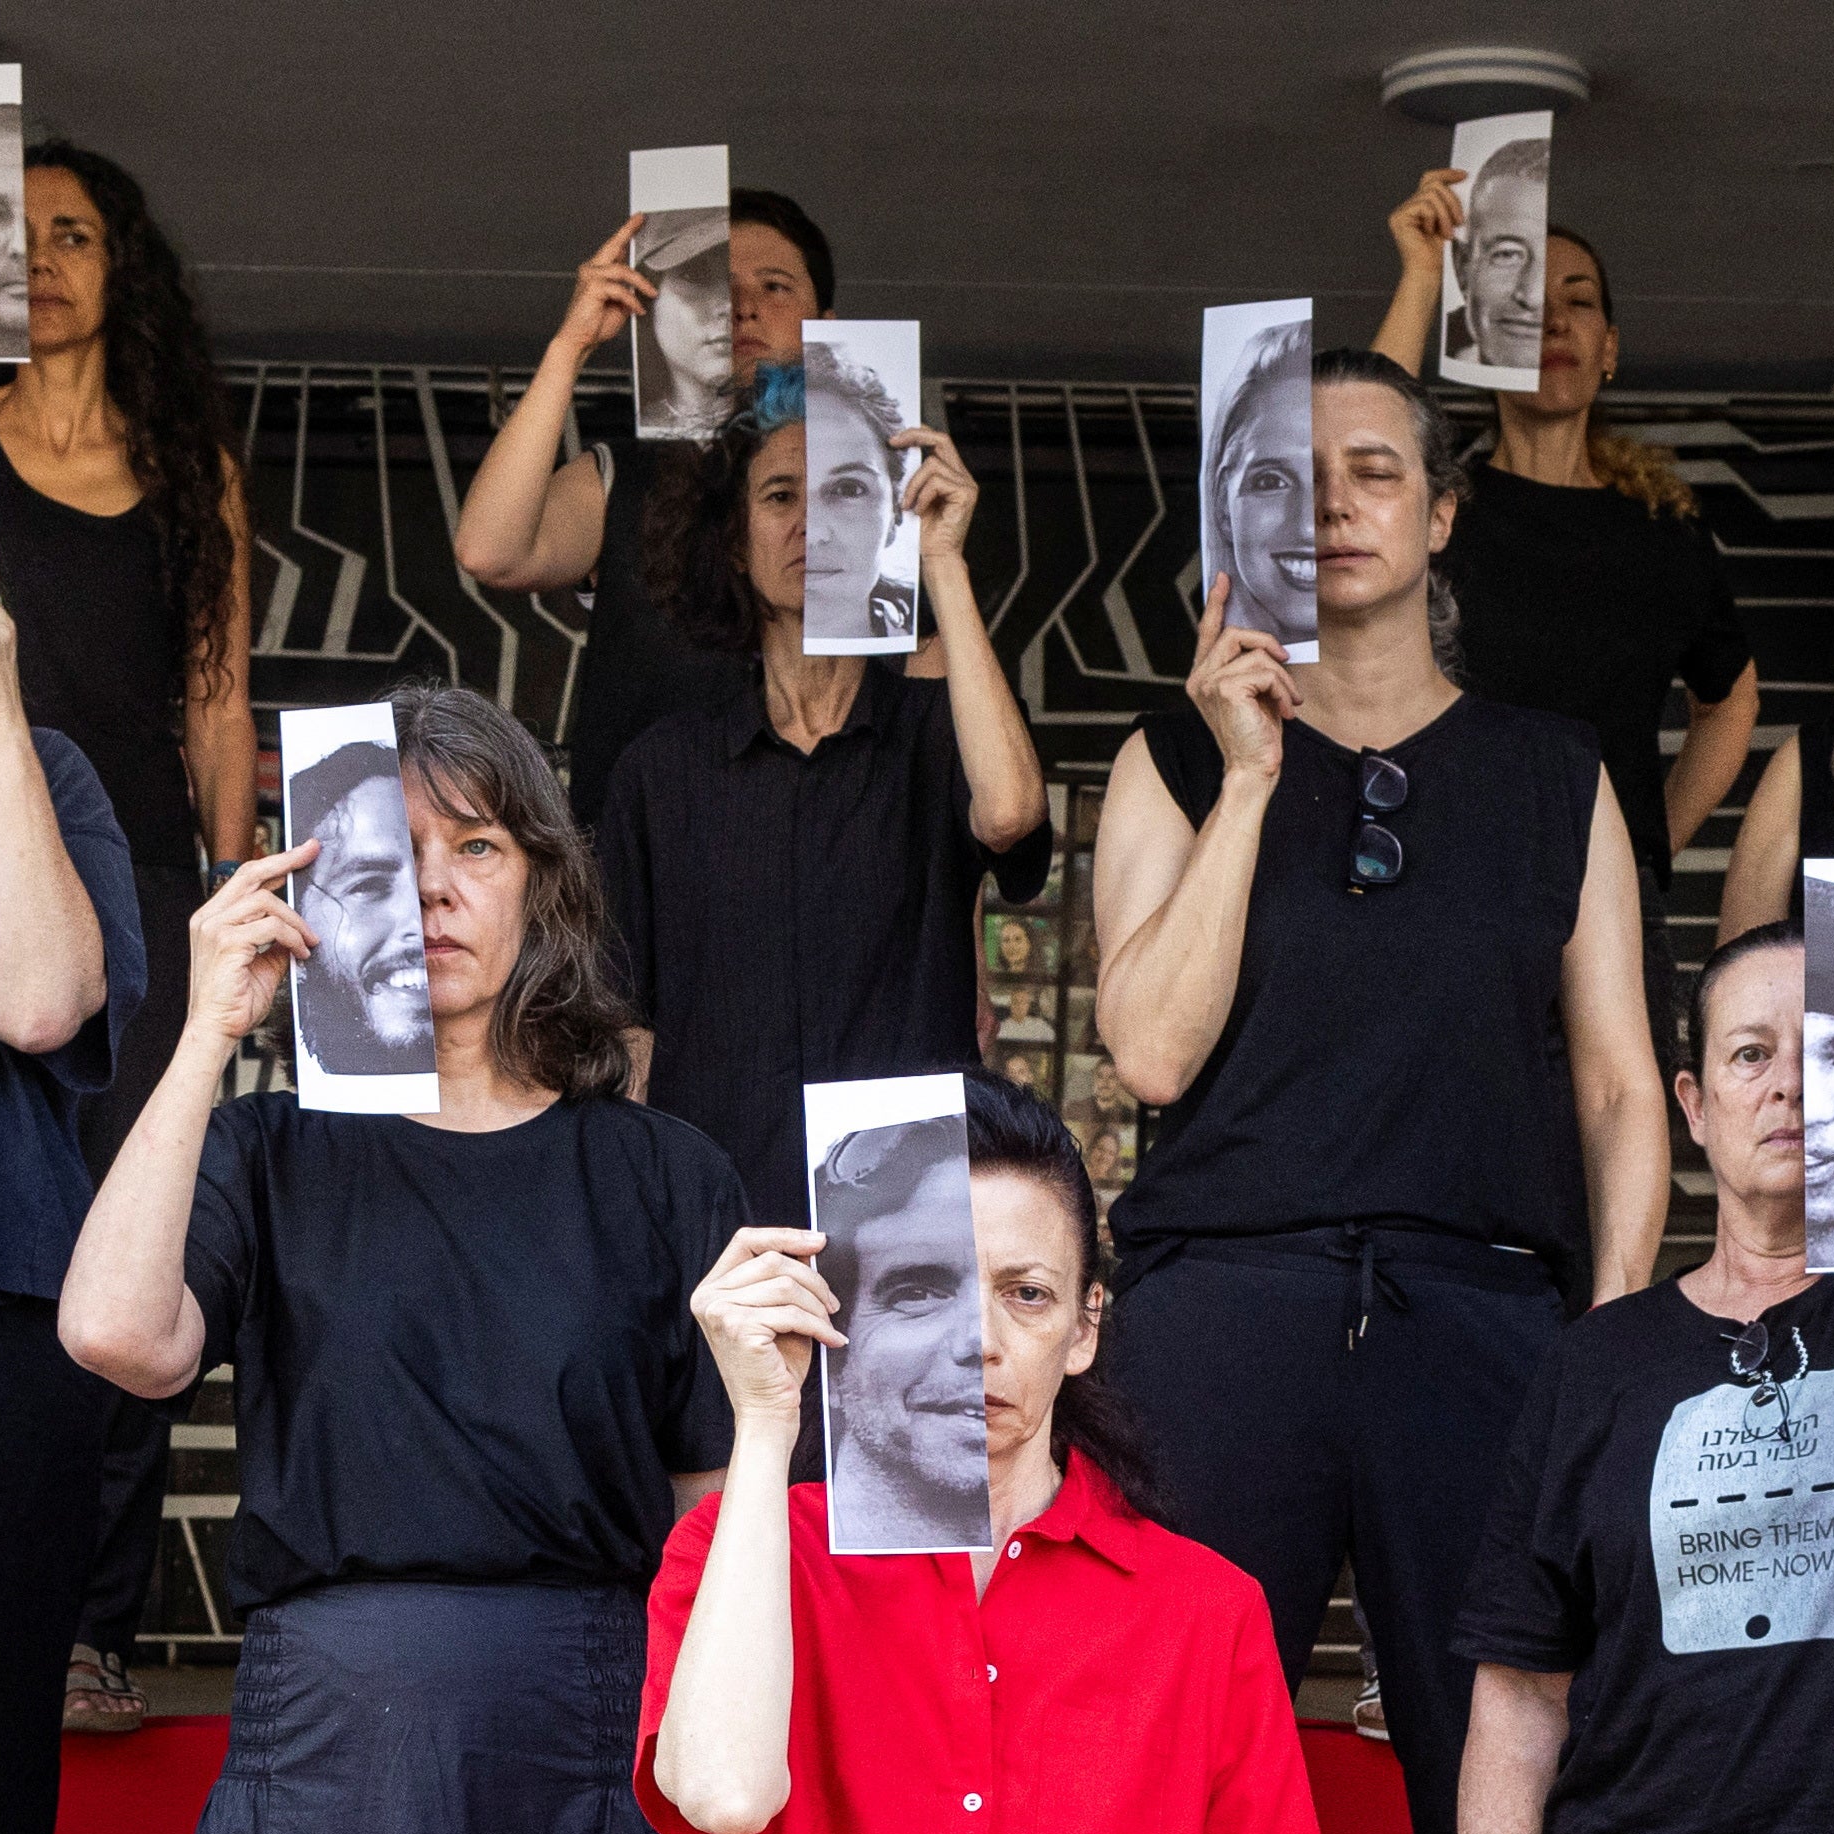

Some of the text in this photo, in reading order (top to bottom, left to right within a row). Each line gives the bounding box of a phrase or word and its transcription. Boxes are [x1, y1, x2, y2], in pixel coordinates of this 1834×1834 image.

[1701, 1426, 1761, 1446] שלנו
[1697, 1439, 1818, 1472] שבוי בעזה
[1679, 1528, 1762, 1556] BRING
